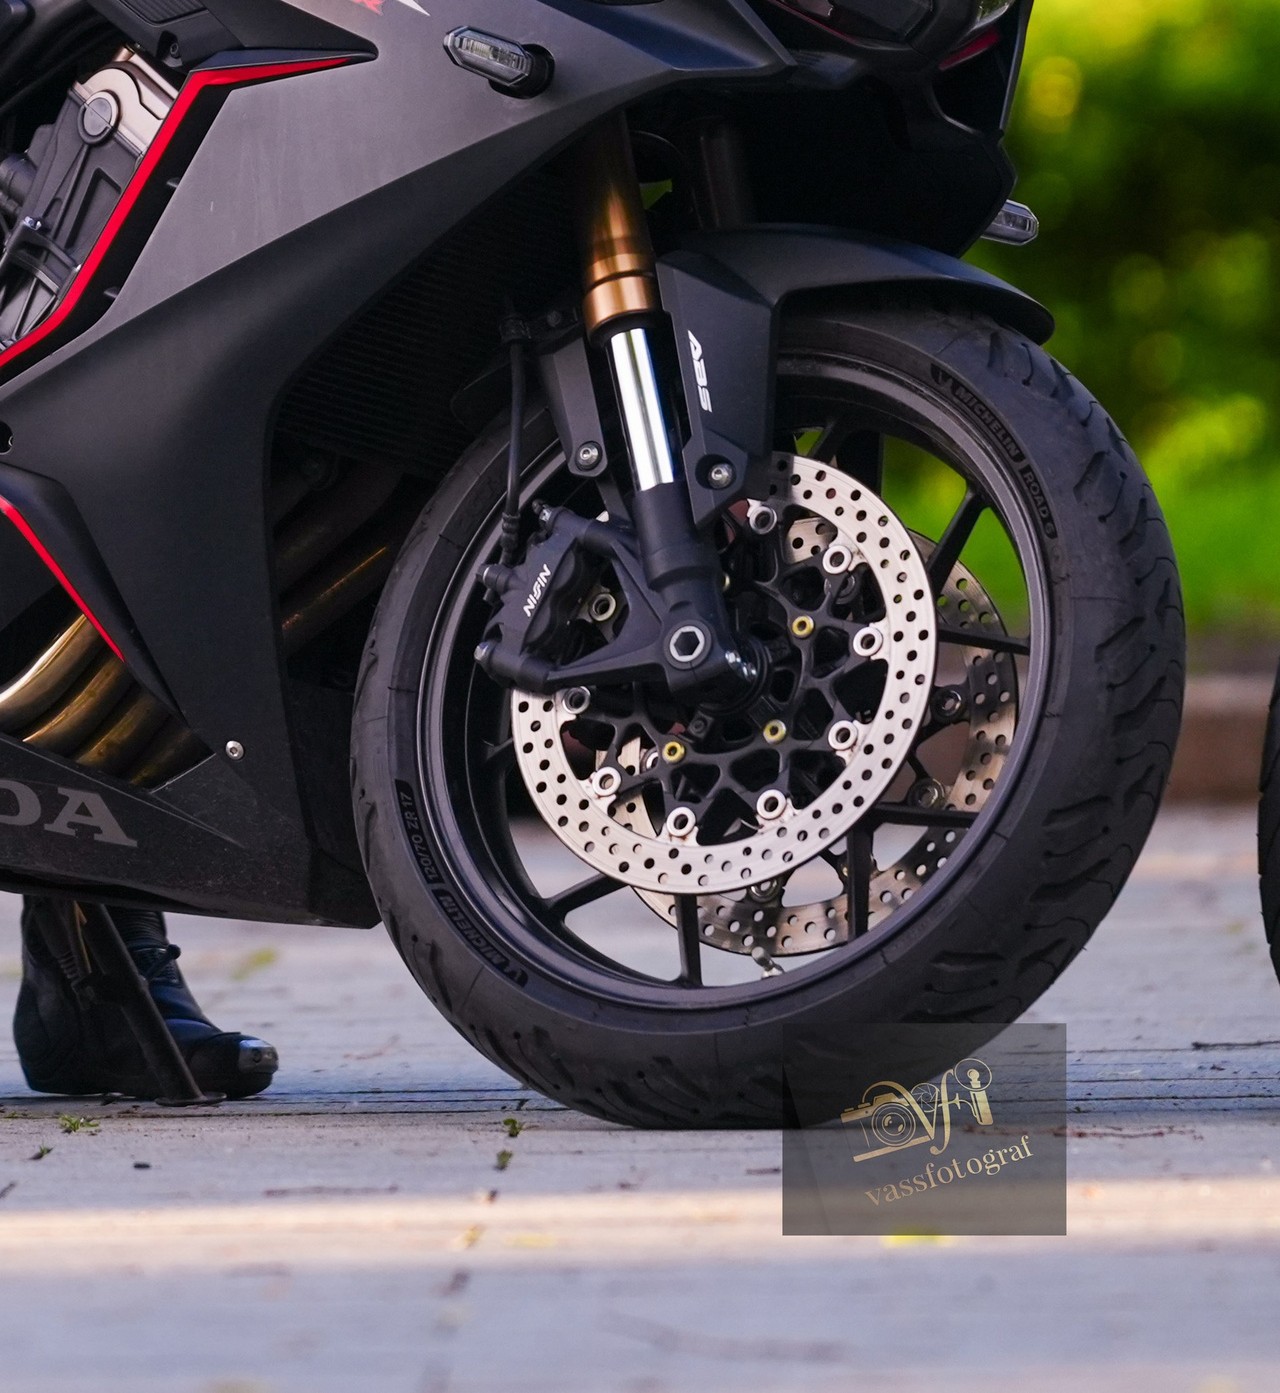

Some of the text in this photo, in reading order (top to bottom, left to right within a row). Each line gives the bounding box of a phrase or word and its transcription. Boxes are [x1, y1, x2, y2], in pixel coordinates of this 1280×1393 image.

[687, 329, 713, 413] ABS
[954, 386, 1021, 458] MICHELIN
[1023, 471, 1050, 519] ROAD
[411, 835, 439, 882] 120/70
[438, 895, 506, 966] MICHELIN
